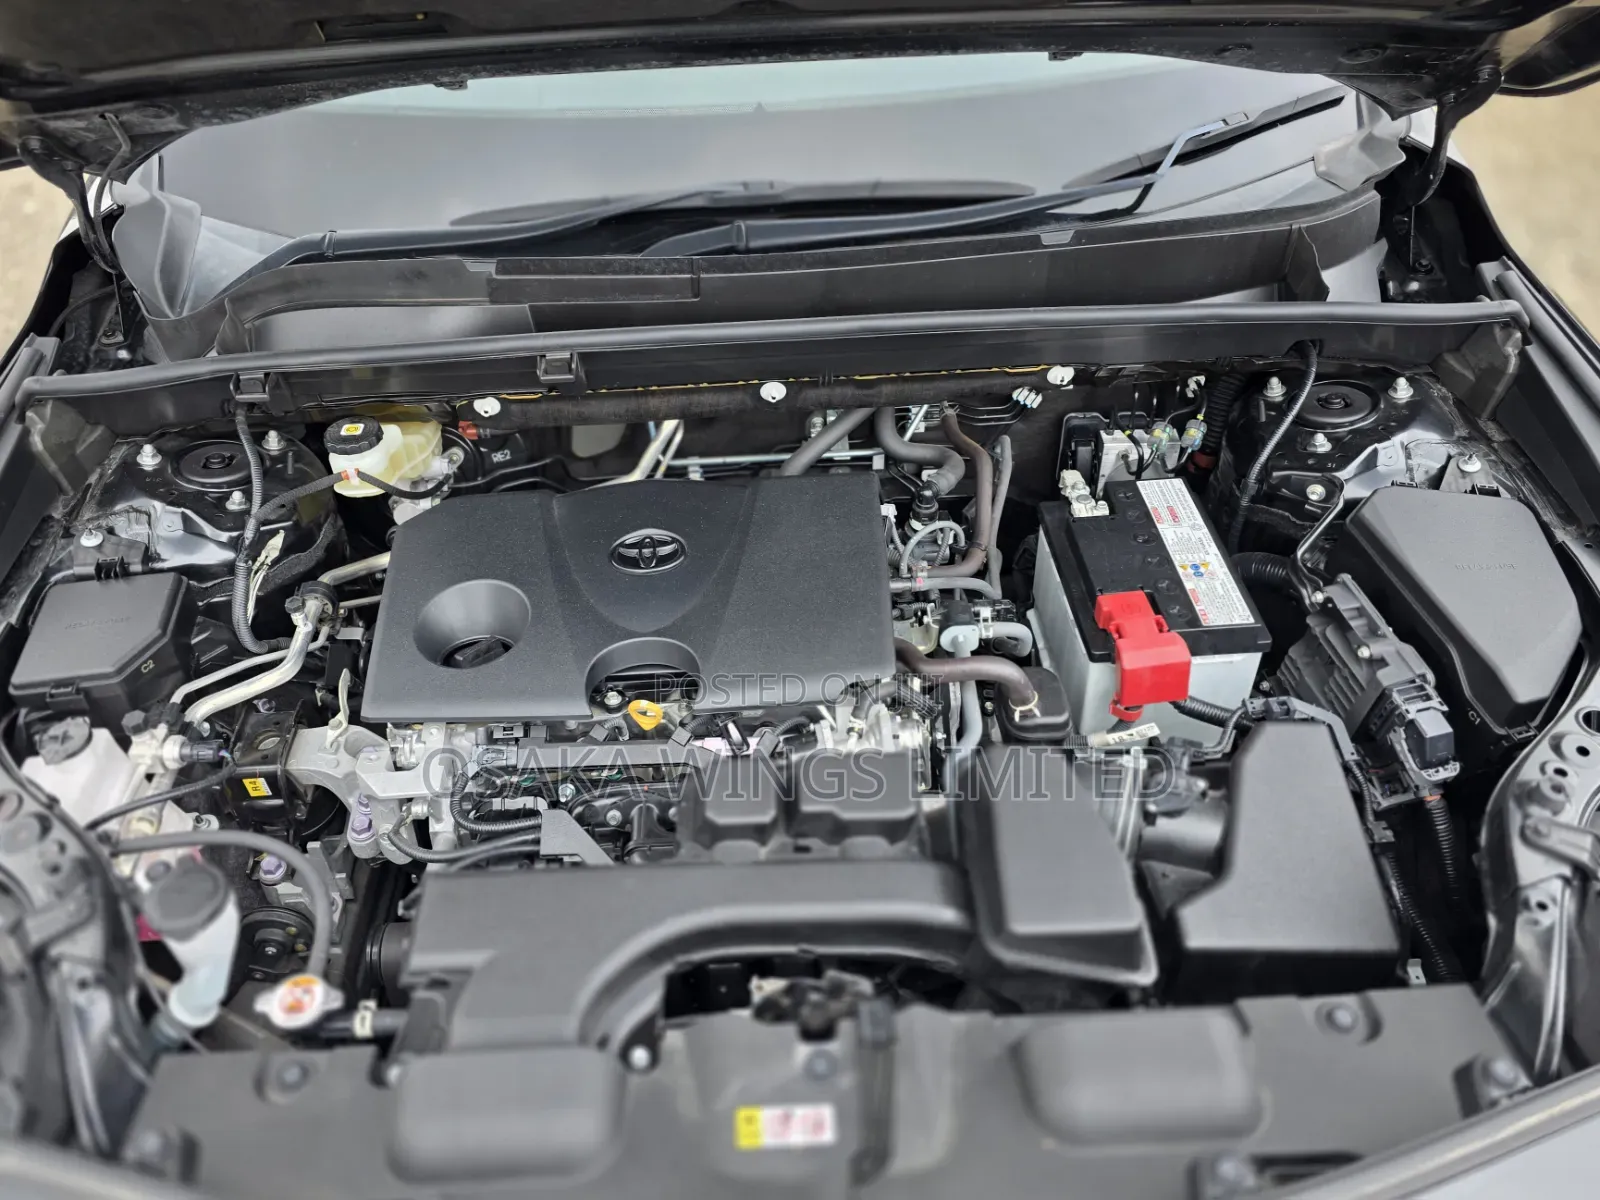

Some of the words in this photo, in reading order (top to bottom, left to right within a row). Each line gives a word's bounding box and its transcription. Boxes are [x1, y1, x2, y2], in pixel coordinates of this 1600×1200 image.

[491, 449, 512, 464] RE2
[141, 659, 155, 673] C2
[1468, 710, 1481, 725] C1
